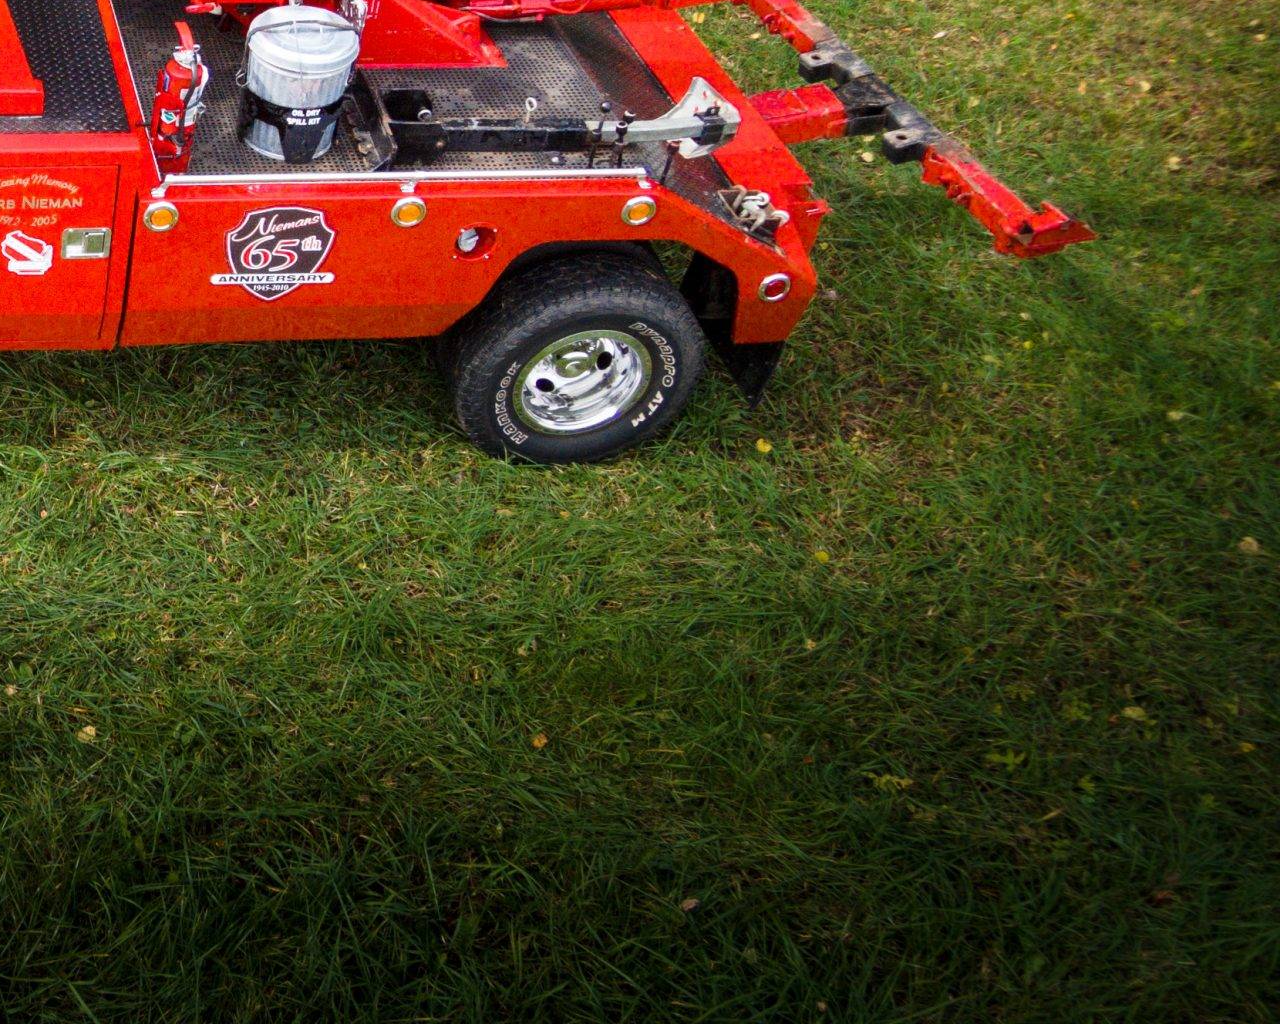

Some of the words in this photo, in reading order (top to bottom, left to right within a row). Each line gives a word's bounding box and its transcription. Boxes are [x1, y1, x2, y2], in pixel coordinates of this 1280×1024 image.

[306, 108, 321, 117] DRY
[287, 117, 307, 126] SPILL
[308, 117, 321, 126] KIT
[30, 173, 79, 194] Memory
[22, 195, 83, 209] NIEMAN
[231, 214, 320, 242] Niemans
[218, 275, 327, 283] ANNIVERSARY
